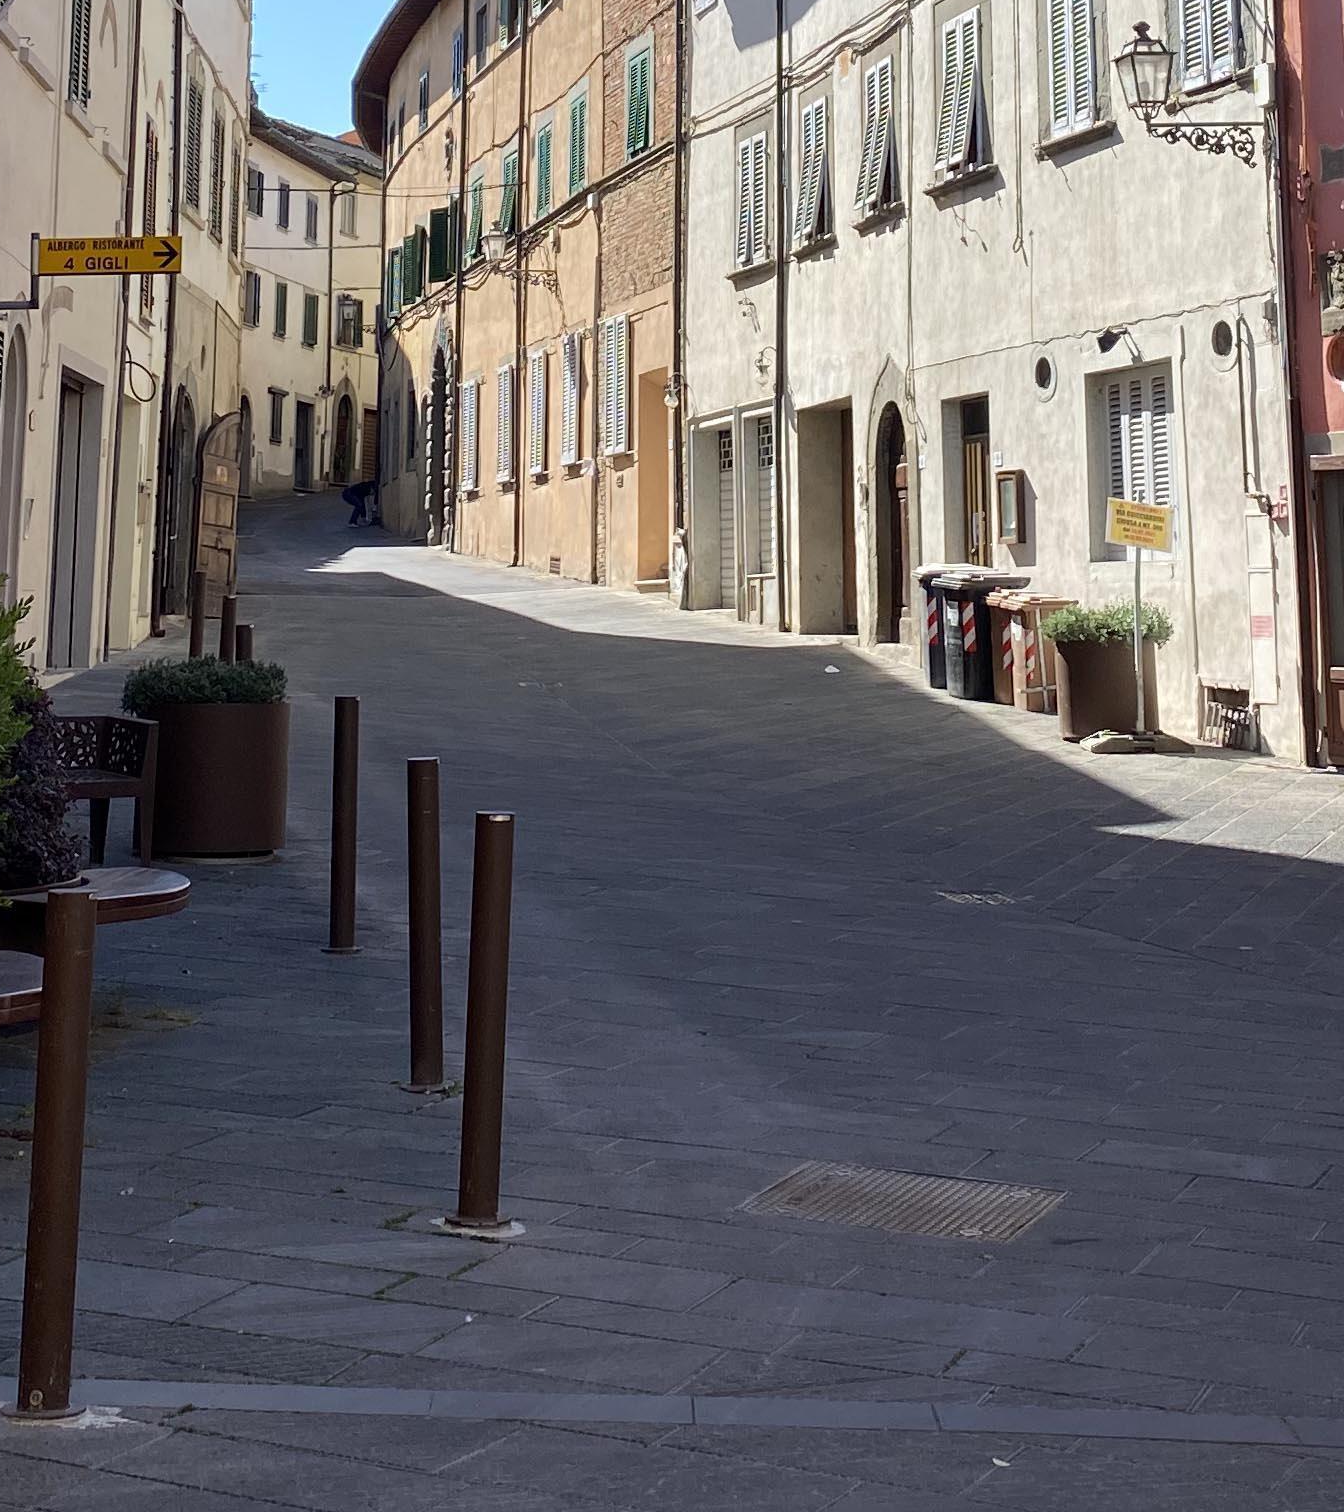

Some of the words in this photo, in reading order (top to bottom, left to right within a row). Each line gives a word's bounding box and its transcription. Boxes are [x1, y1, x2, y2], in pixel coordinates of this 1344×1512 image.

[47, 239, 86, 252] ALBERGO
[92, 239, 145, 250] RISTORANTE
[63, 257, 75, 270] 4
[85, 256, 129, 270] GIGLI
